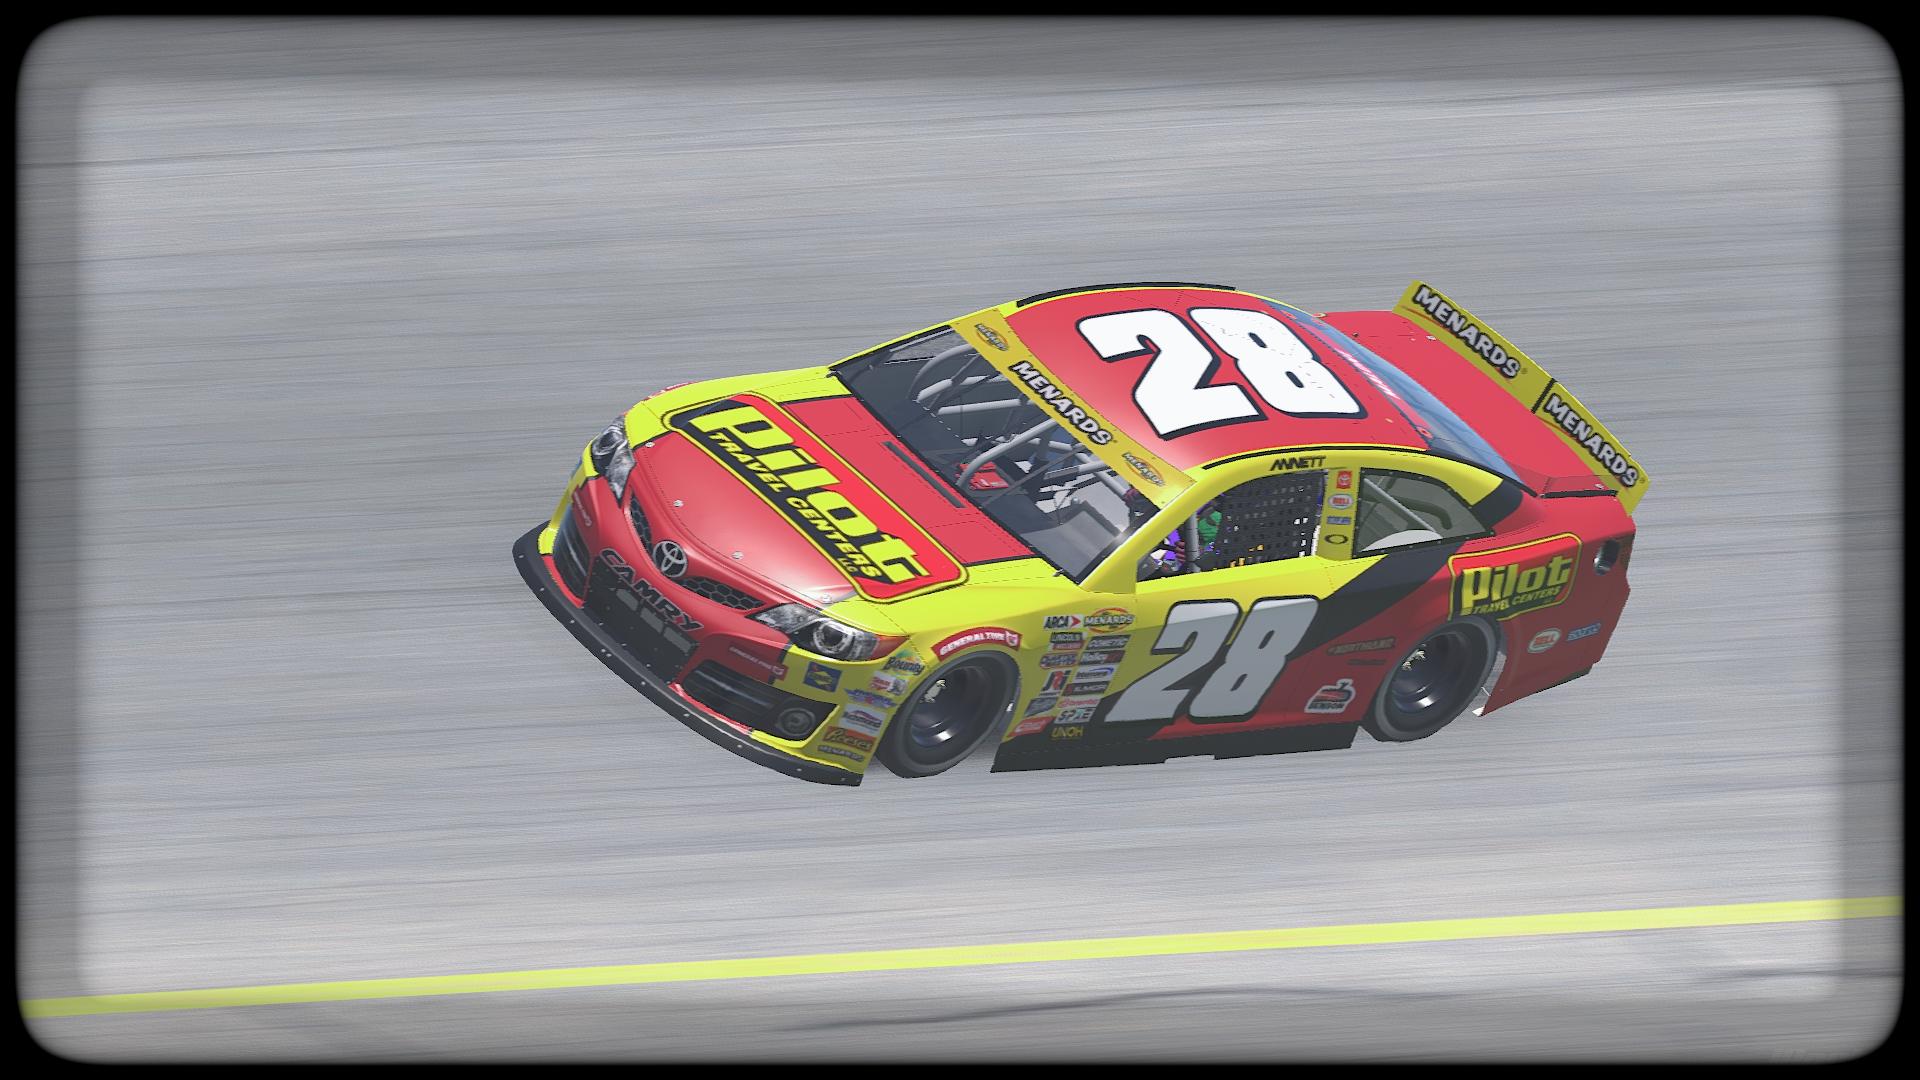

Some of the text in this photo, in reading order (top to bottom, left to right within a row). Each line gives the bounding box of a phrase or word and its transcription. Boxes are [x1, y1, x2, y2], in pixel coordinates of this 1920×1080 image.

[1077, 306, 1365, 439] 28
[1412, 284, 1521, 380] MENARDS
[1008, 360, 1114, 446] MENARDS
[1543, 394, 1640, 489] MENARDS
[708, 432, 882, 577] TRAVEL CENTERS
[600, 547, 705, 632] CAMRY
[1043, 615, 1069, 629] ARCA
[1083, 613, 1135, 628] MENARDS
[1473, 586, 1561, 615] TRAVEL CENTERS
[939, 633, 984, 656] GENERAL
[1104, 596, 1319, 723] 28
